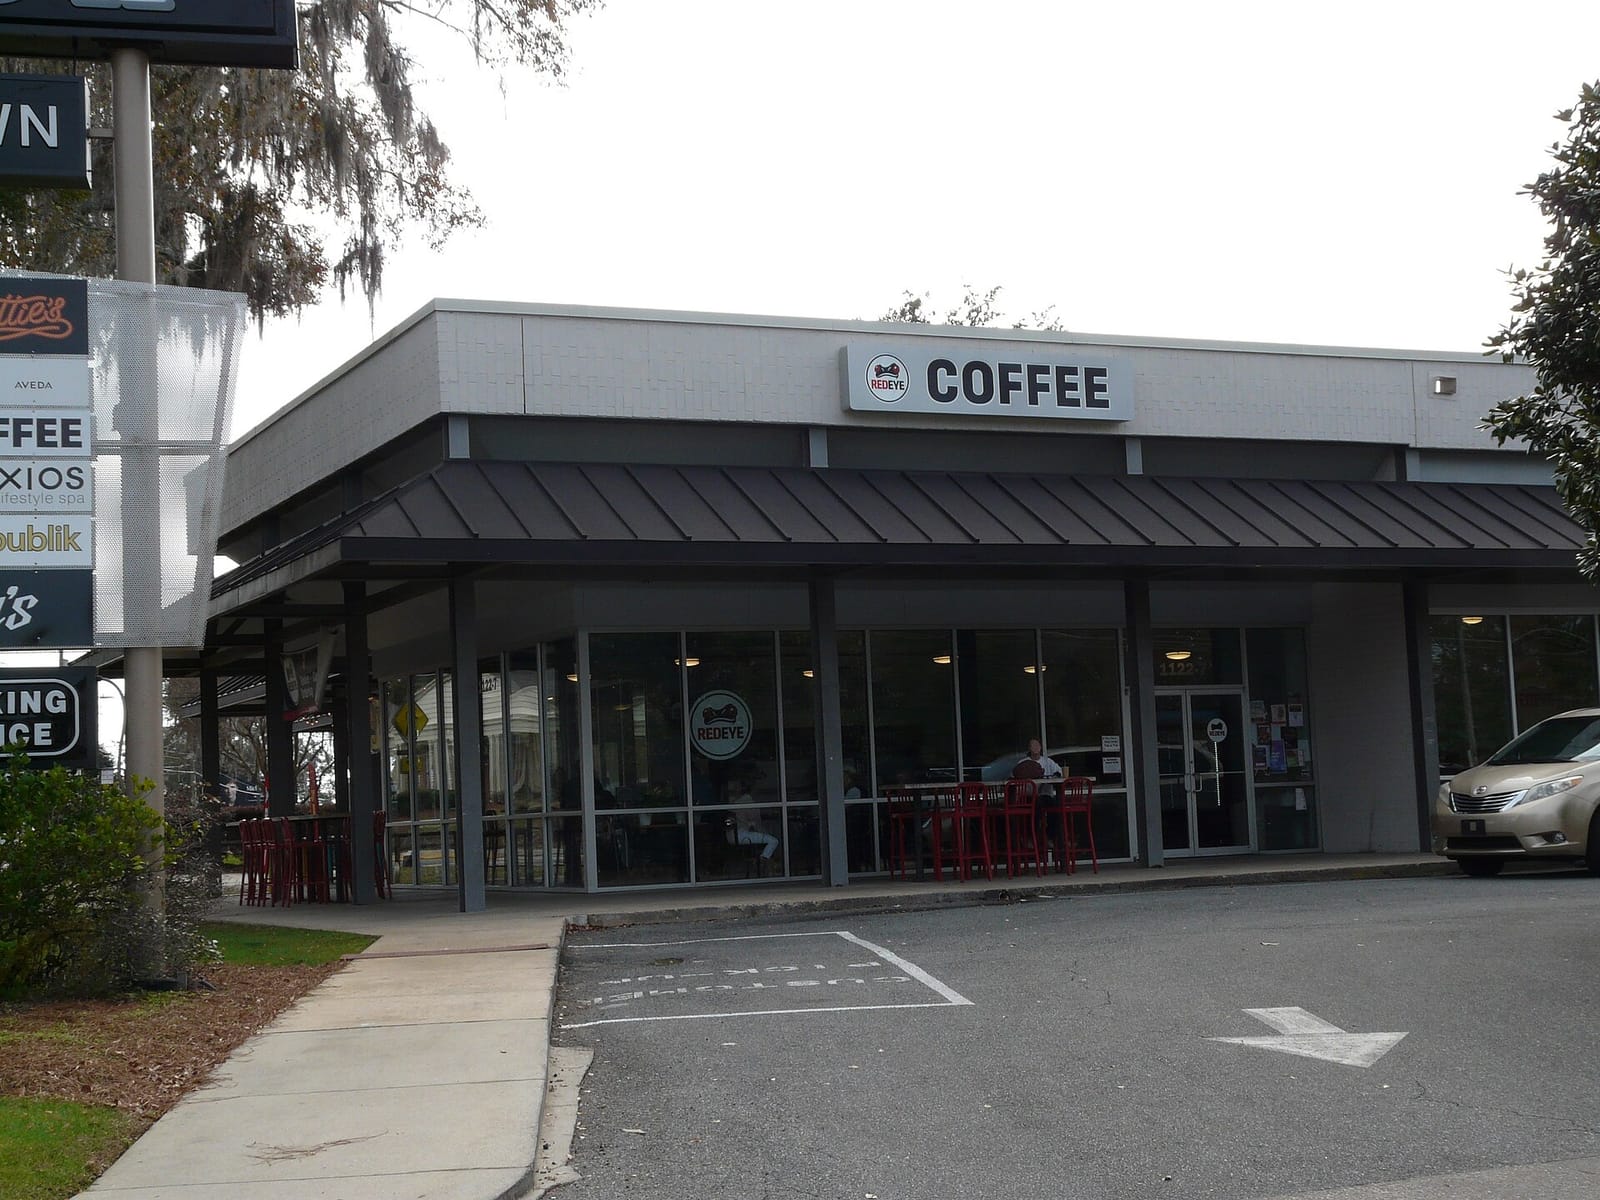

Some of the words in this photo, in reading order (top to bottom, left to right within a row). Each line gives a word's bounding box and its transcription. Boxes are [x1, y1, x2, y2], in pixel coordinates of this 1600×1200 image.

[14, 381, 53, 390] AVEDA
[871, 379, 905, 391] REDEYE
[926, 358, 1110, 409] COFFEE
[0, 466, 85, 490] XIOS
[58, 494, 85, 506] spa
[0, 689, 67, 714] ING
[697, 726, 745, 741] REDEYE
